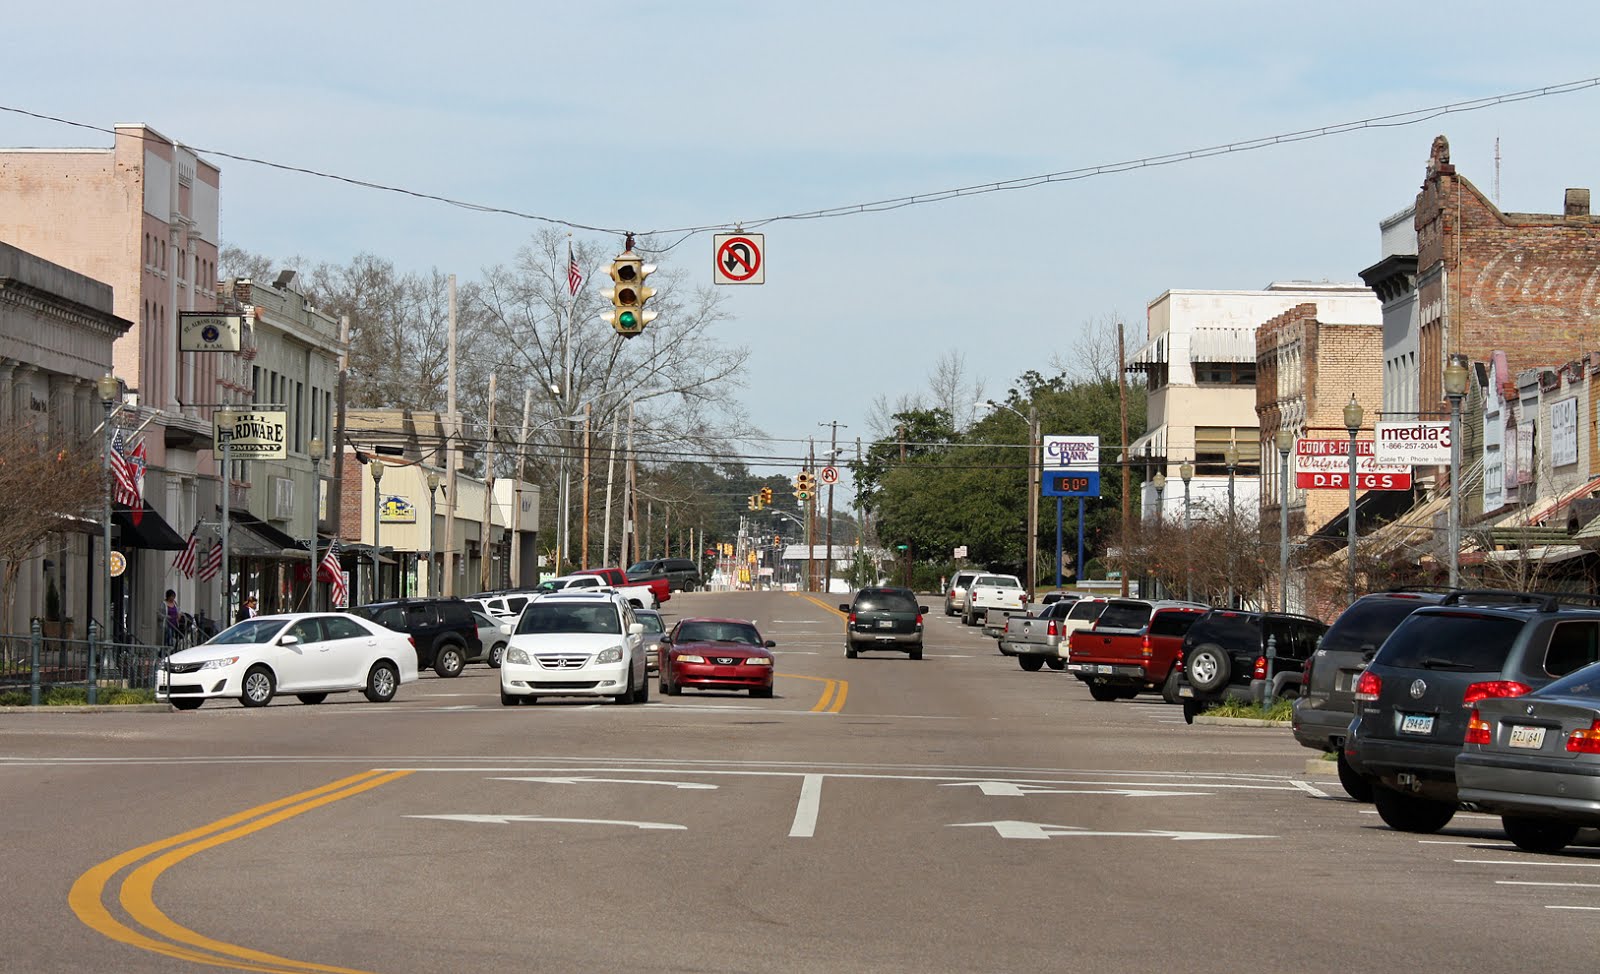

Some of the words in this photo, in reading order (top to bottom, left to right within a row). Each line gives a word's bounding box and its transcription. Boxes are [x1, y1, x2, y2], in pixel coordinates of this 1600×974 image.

[1299, 441, 1327, 454] COOK
[1382, 442, 1438, 450] 1-866-257-2044
[1059, 451, 1089, 467] BANK
[1297, 455, 1351, 470] Walgree
[1410, 455, 1430, 463] Phone
